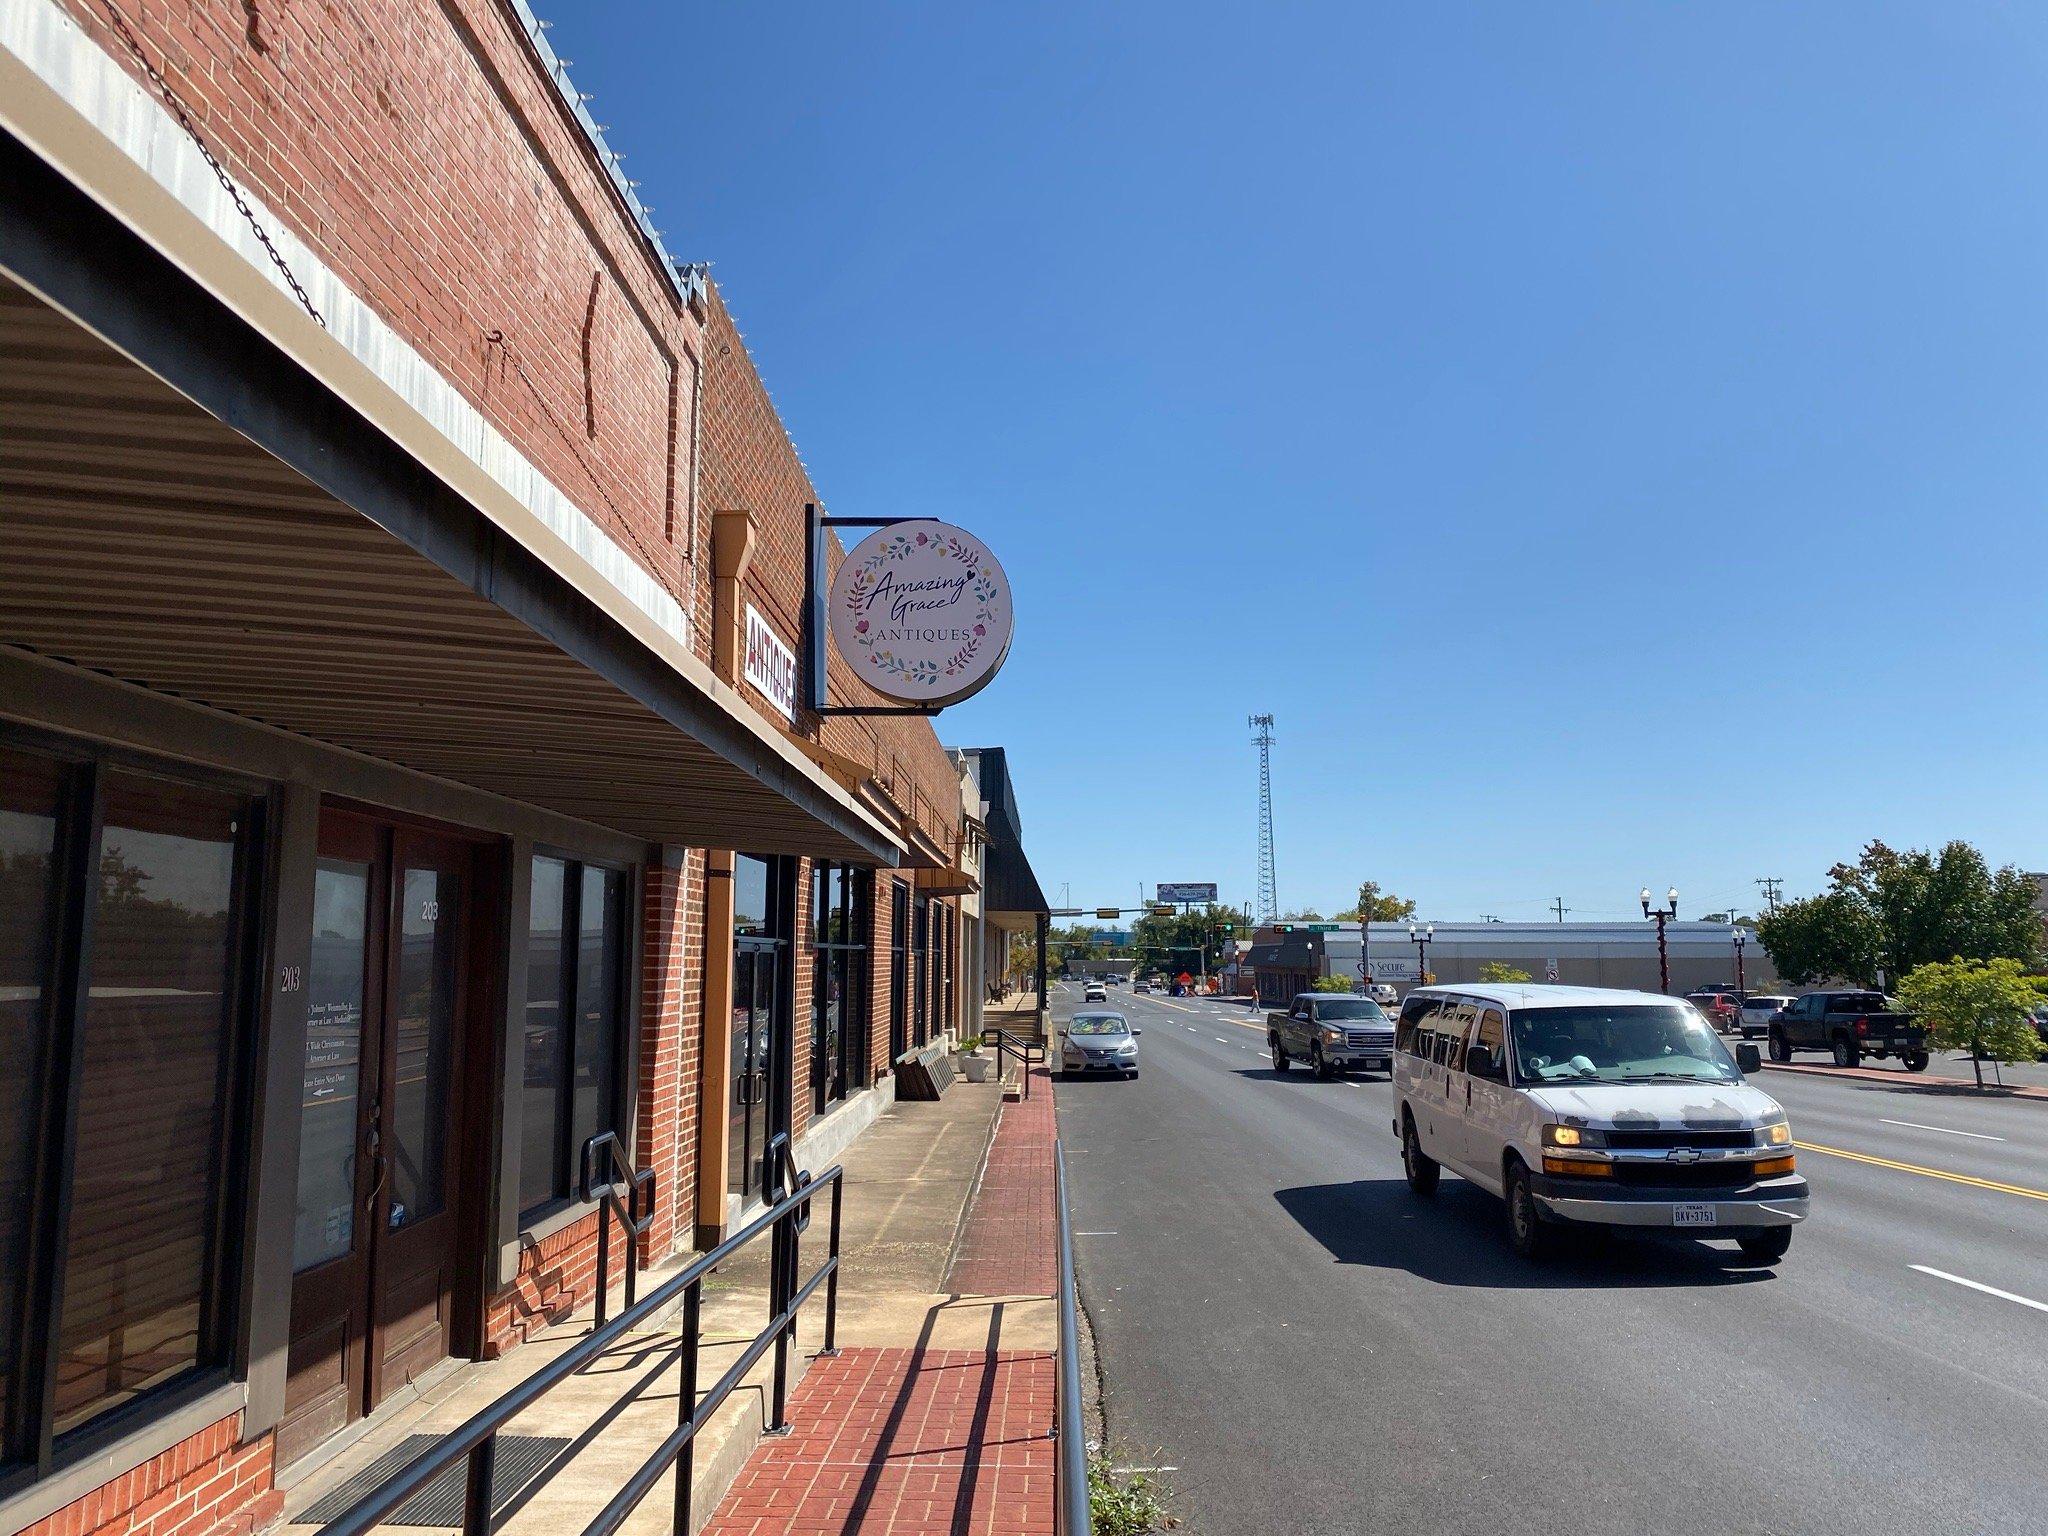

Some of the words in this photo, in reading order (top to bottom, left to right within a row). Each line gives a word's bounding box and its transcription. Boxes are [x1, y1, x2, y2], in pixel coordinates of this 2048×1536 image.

[865, 571, 968, 609] Amazing
[891, 594, 950, 626] Grace
[876, 629, 970, 642] ANTIQUES
[422, 901, 438, 921] 203
[1377, 961, 1405, 972] Secure
[281, 966, 300, 992] 203
